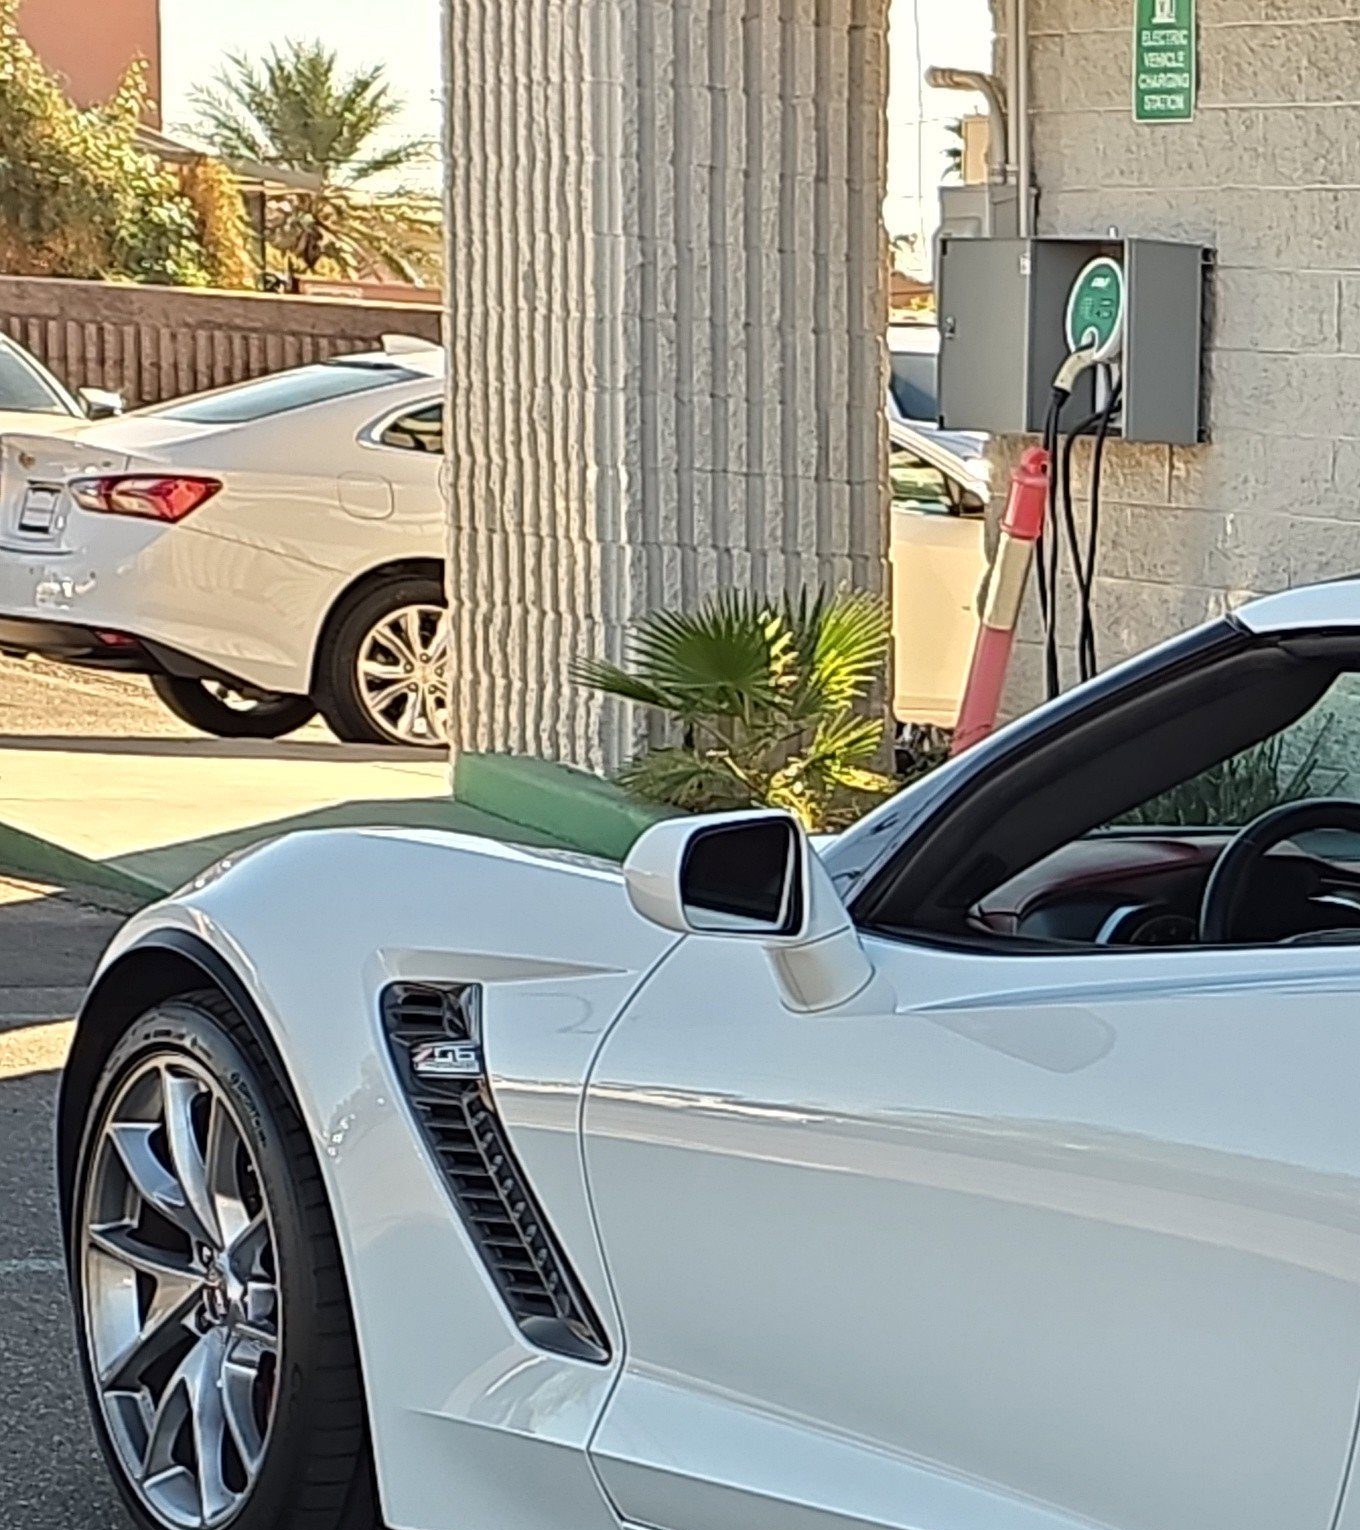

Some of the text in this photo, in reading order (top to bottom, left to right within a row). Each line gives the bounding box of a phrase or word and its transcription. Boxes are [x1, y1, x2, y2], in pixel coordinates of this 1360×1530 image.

[1141, 29, 1189, 46] ELECTRIC
[1143, 50, 1185, 68] VEHICLE
[1138, 72, 1190, 89] CHARGING
[1143, 93, 1185, 110] STATION
